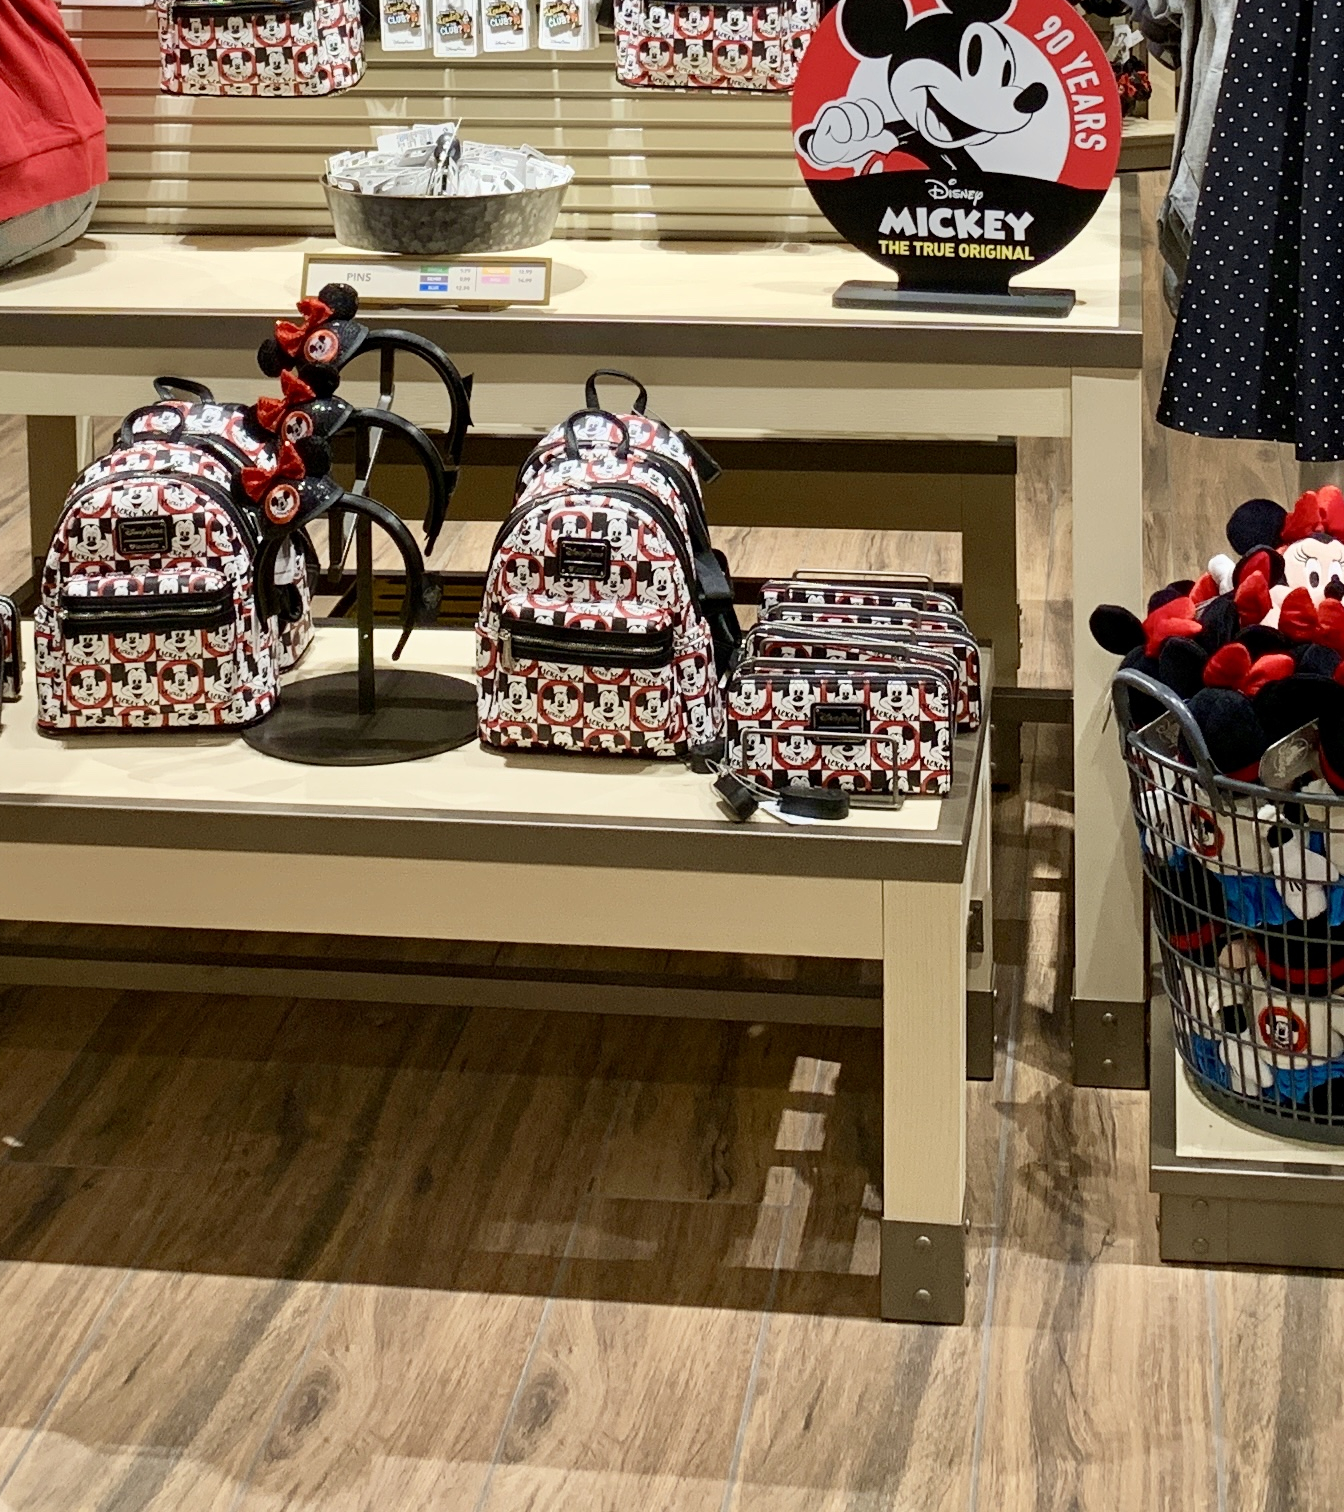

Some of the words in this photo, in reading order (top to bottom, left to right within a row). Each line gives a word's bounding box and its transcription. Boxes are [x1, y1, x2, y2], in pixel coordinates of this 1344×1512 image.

[387, 14, 410, 26] CLUB?
[490, 15, 513, 27] CLUB?
[548, 15, 571, 28] CLUB?
[439, 24, 463, 36] CLUB?
[1033, 15, 1076, 56] 90
[1060, 50, 1108, 152] YEARS
[924, 178, 985, 207] Disney
[878, 206, 1035, 241] MICKEY
[878, 239, 911, 256] THE
[913, 241, 956, 258] TRUE
[958, 243, 1036, 262] ORIGINAL
[346, 273, 372, 282] PINS
